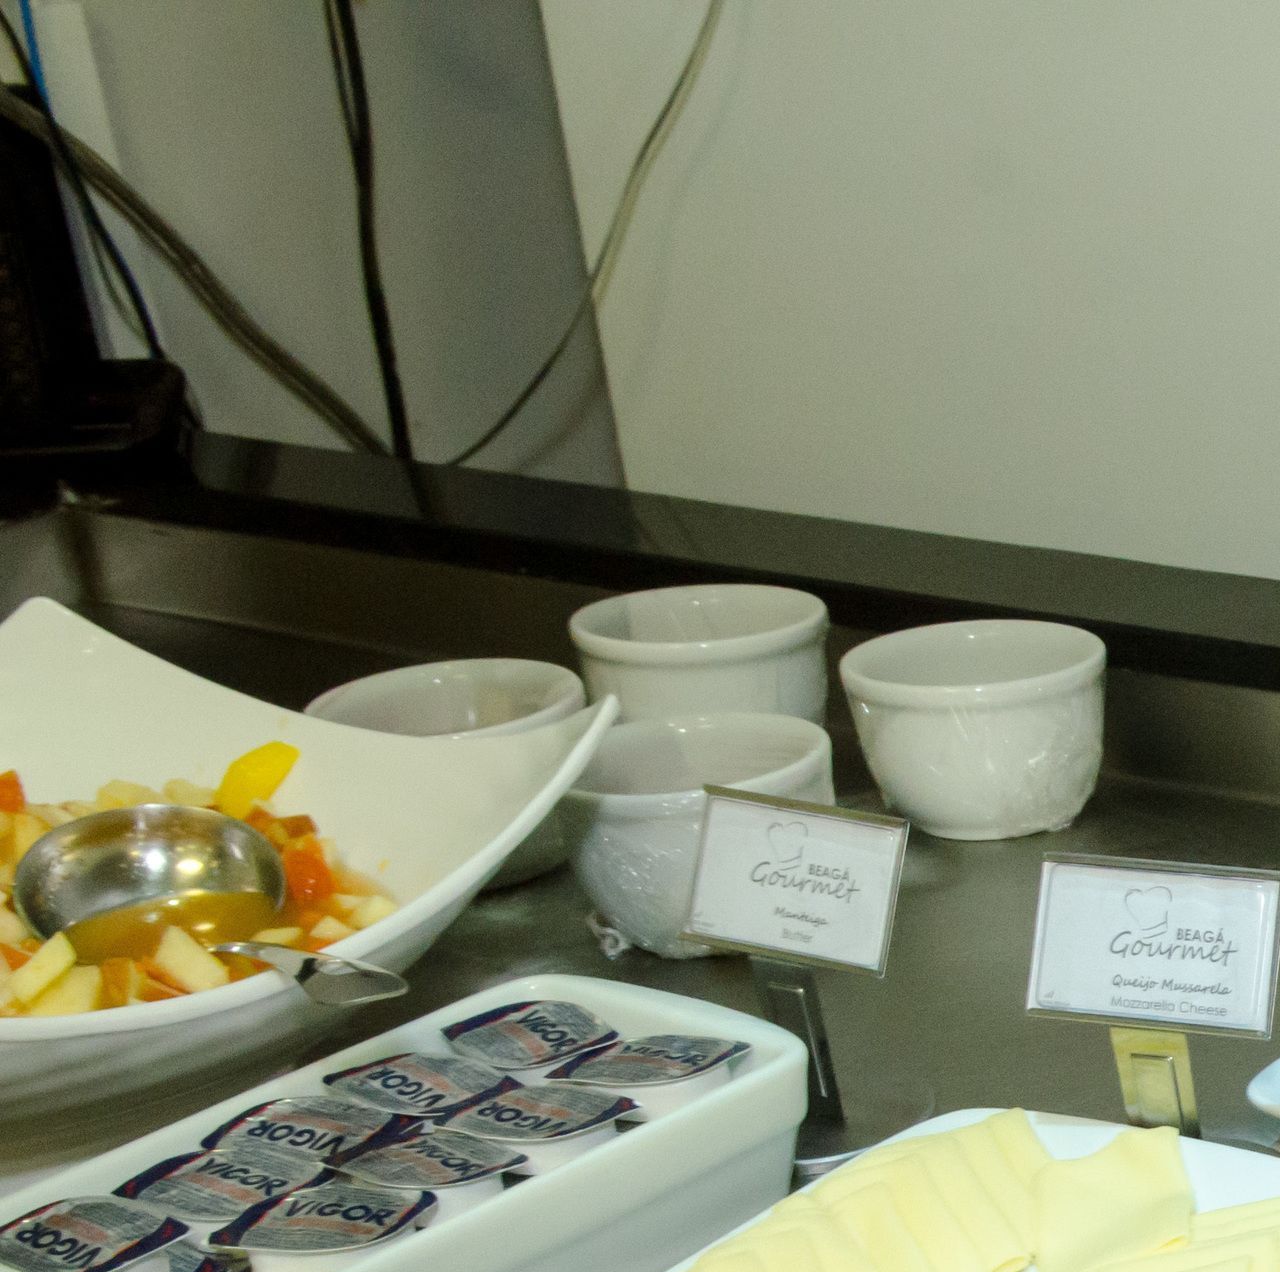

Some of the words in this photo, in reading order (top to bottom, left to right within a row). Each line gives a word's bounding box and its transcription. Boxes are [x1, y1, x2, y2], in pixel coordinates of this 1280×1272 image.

[751, 861, 860, 903] Gourmet
[1109, 930, 1239, 966] Gourmet
[1176, 927, 1225, 944] BEAGÁ
[1112, 974, 1159, 992] Queijo
[1161, 977, 1233, 995] Mussarela
[1110, 996, 1176, 1013] Mozzarella
[1179, 1001, 1228, 1017] Cheese
[368, 1066, 446, 1108] VIGOR
[477, 1100, 567, 1132] VIGOR
[247, 1120, 346, 1160] VIGOR
[197, 1156, 289, 1196] VIGOR
[283, 1199, 397, 1227] VIGOR
[16, 1222, 103, 1267] VIGOR
